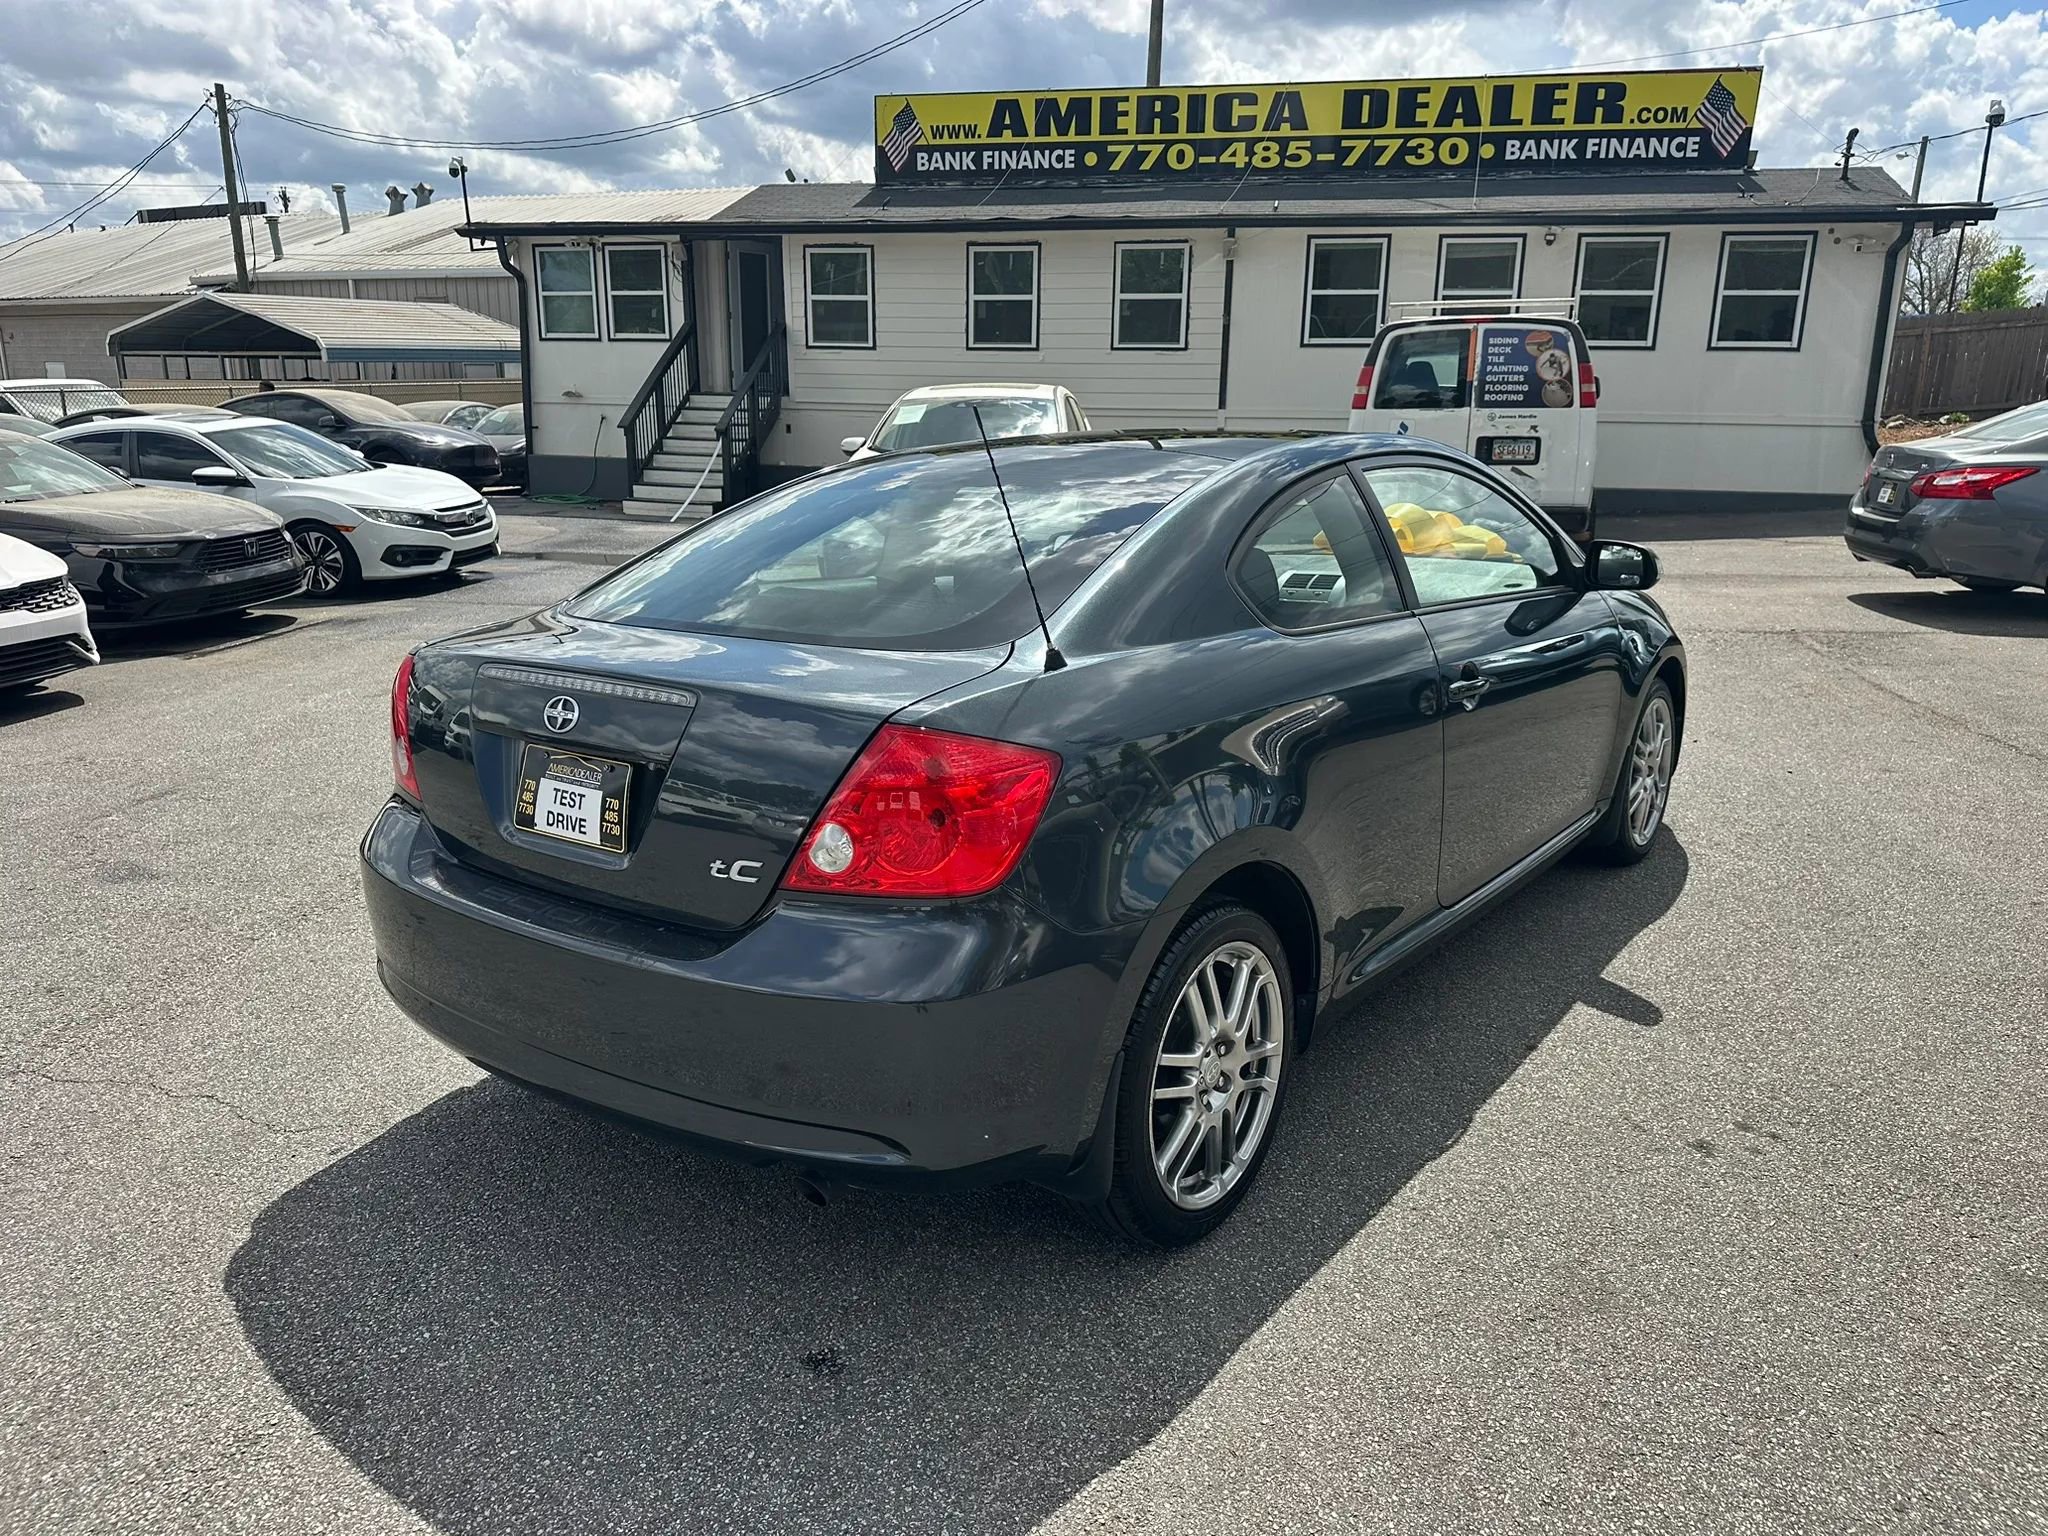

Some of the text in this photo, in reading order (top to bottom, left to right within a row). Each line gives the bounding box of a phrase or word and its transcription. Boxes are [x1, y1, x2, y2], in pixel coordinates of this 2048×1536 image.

[1107, 137, 1470, 171] 770-485-7730
[1504, 137, 1700, 161] BANK FINANCE
[916, 149, 1075, 172] BANK FINANCE
[1488, 346, 1512, 354] DECK
[1487, 355, 1505, 363] TILE
[1485, 374, 1525, 382] GUTTERS
[1484, 393, 1524, 401] ROOFING
[524, 779, 536, 791] 770
[522, 791, 534, 803] 485
[553, 787, 586, 810] TEST
[606, 797, 619, 810] 770
[519, 802, 534, 816] 7730
[546, 810, 587, 835] DRIVE
[604, 810, 618, 823] 485
[602, 822, 621, 836] 7730
[709, 859, 763, 883] tC
